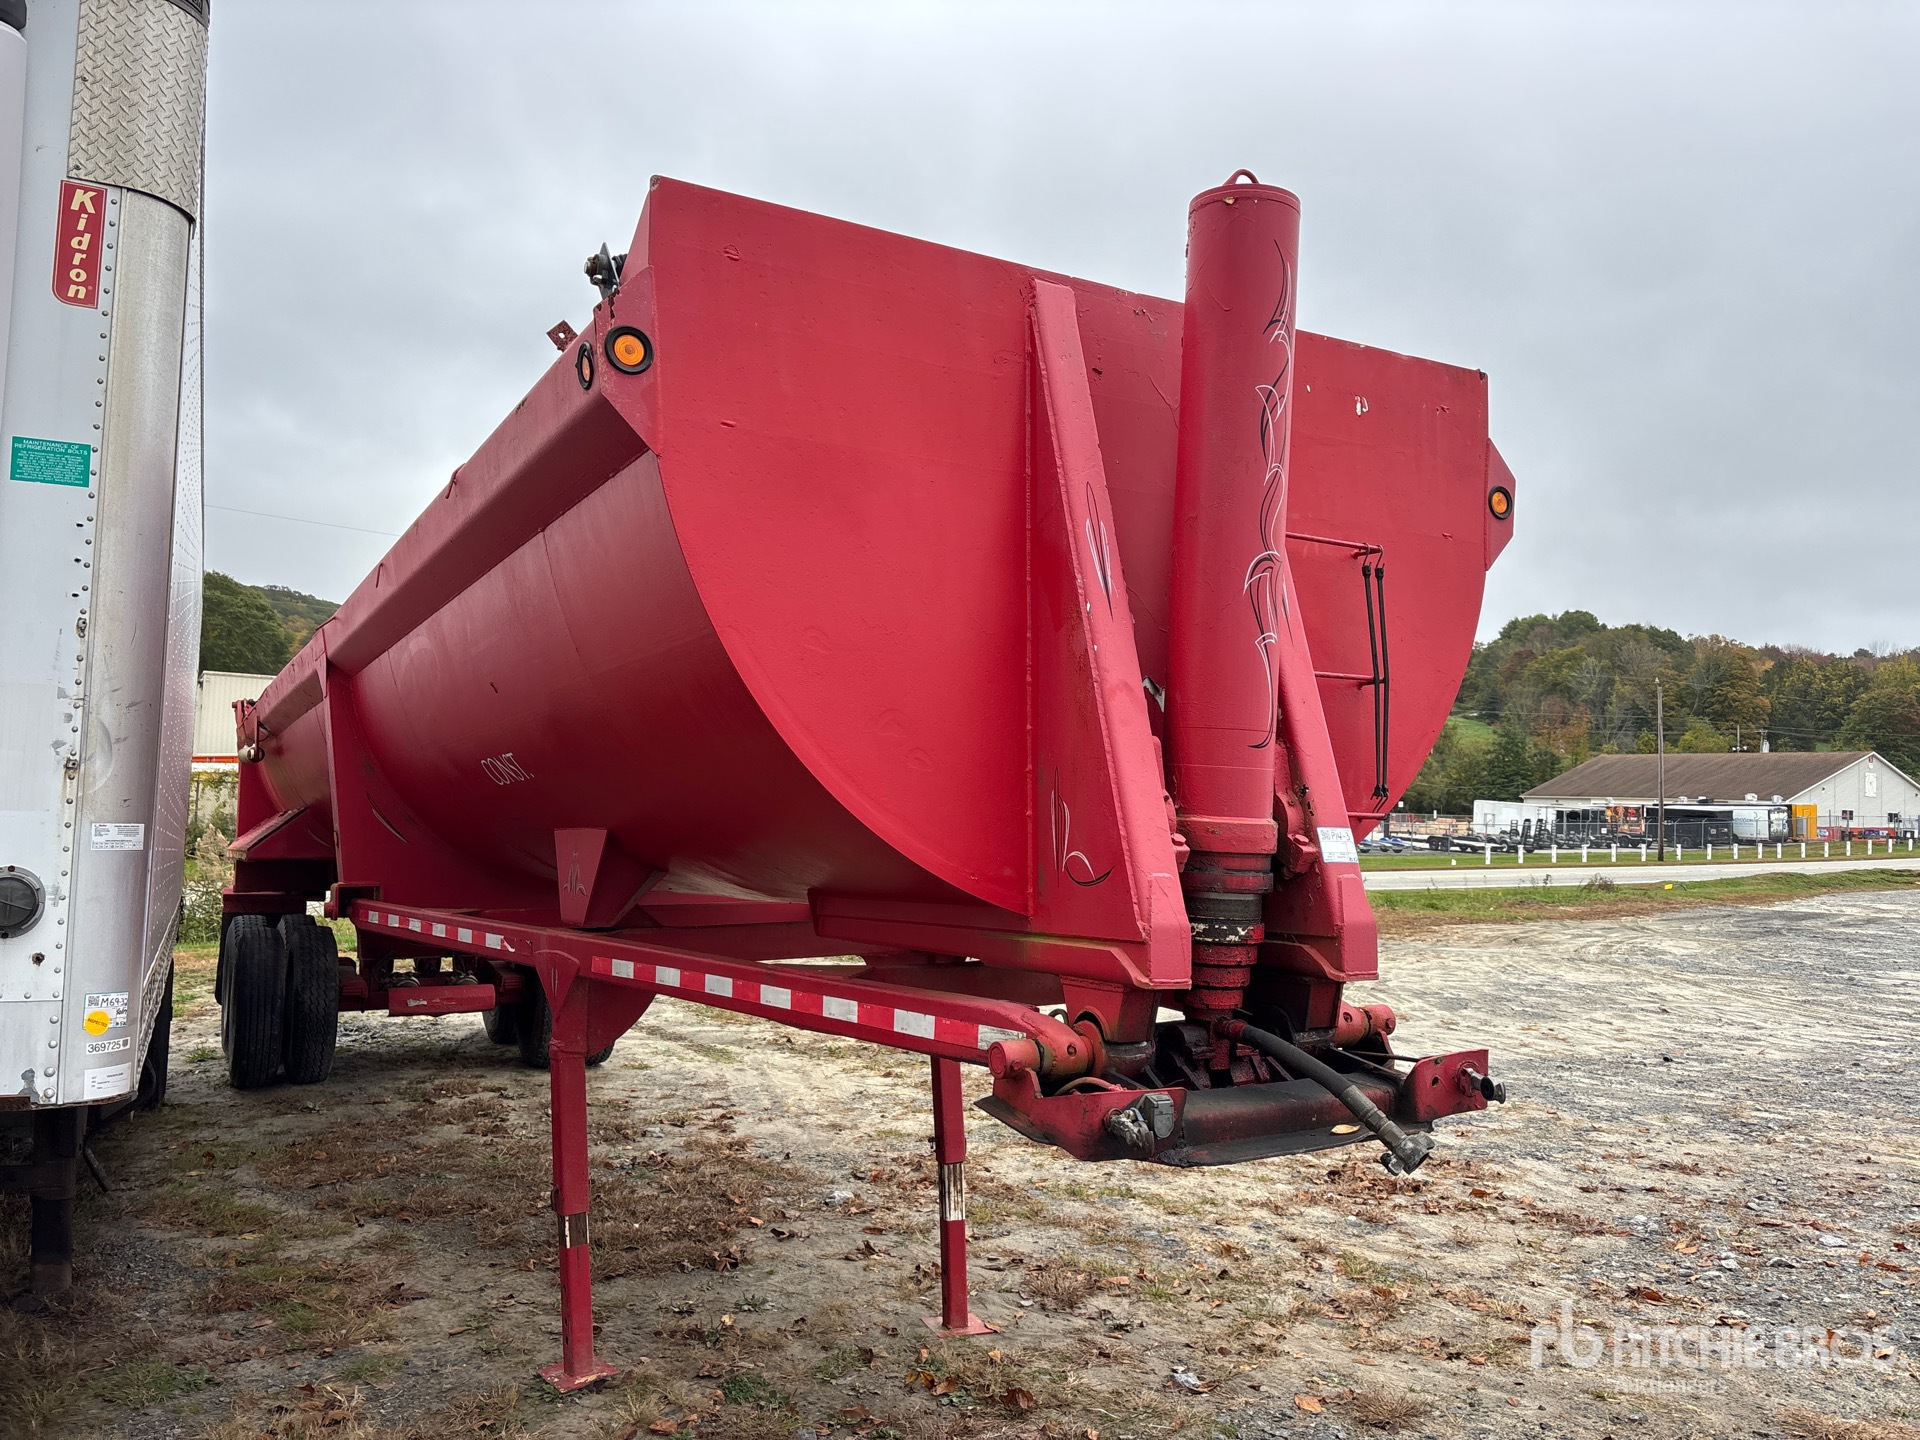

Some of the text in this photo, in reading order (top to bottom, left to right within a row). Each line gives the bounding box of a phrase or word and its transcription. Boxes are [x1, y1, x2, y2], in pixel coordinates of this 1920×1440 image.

[67, 188, 98, 299] Kidron
[14, 443, 65, 453] REFRIGERATION
[23, 440, 68, 449] MAINTENANCE
[480, 752, 535, 786] CONST.
[87, 1040, 121, 1053] 369725
